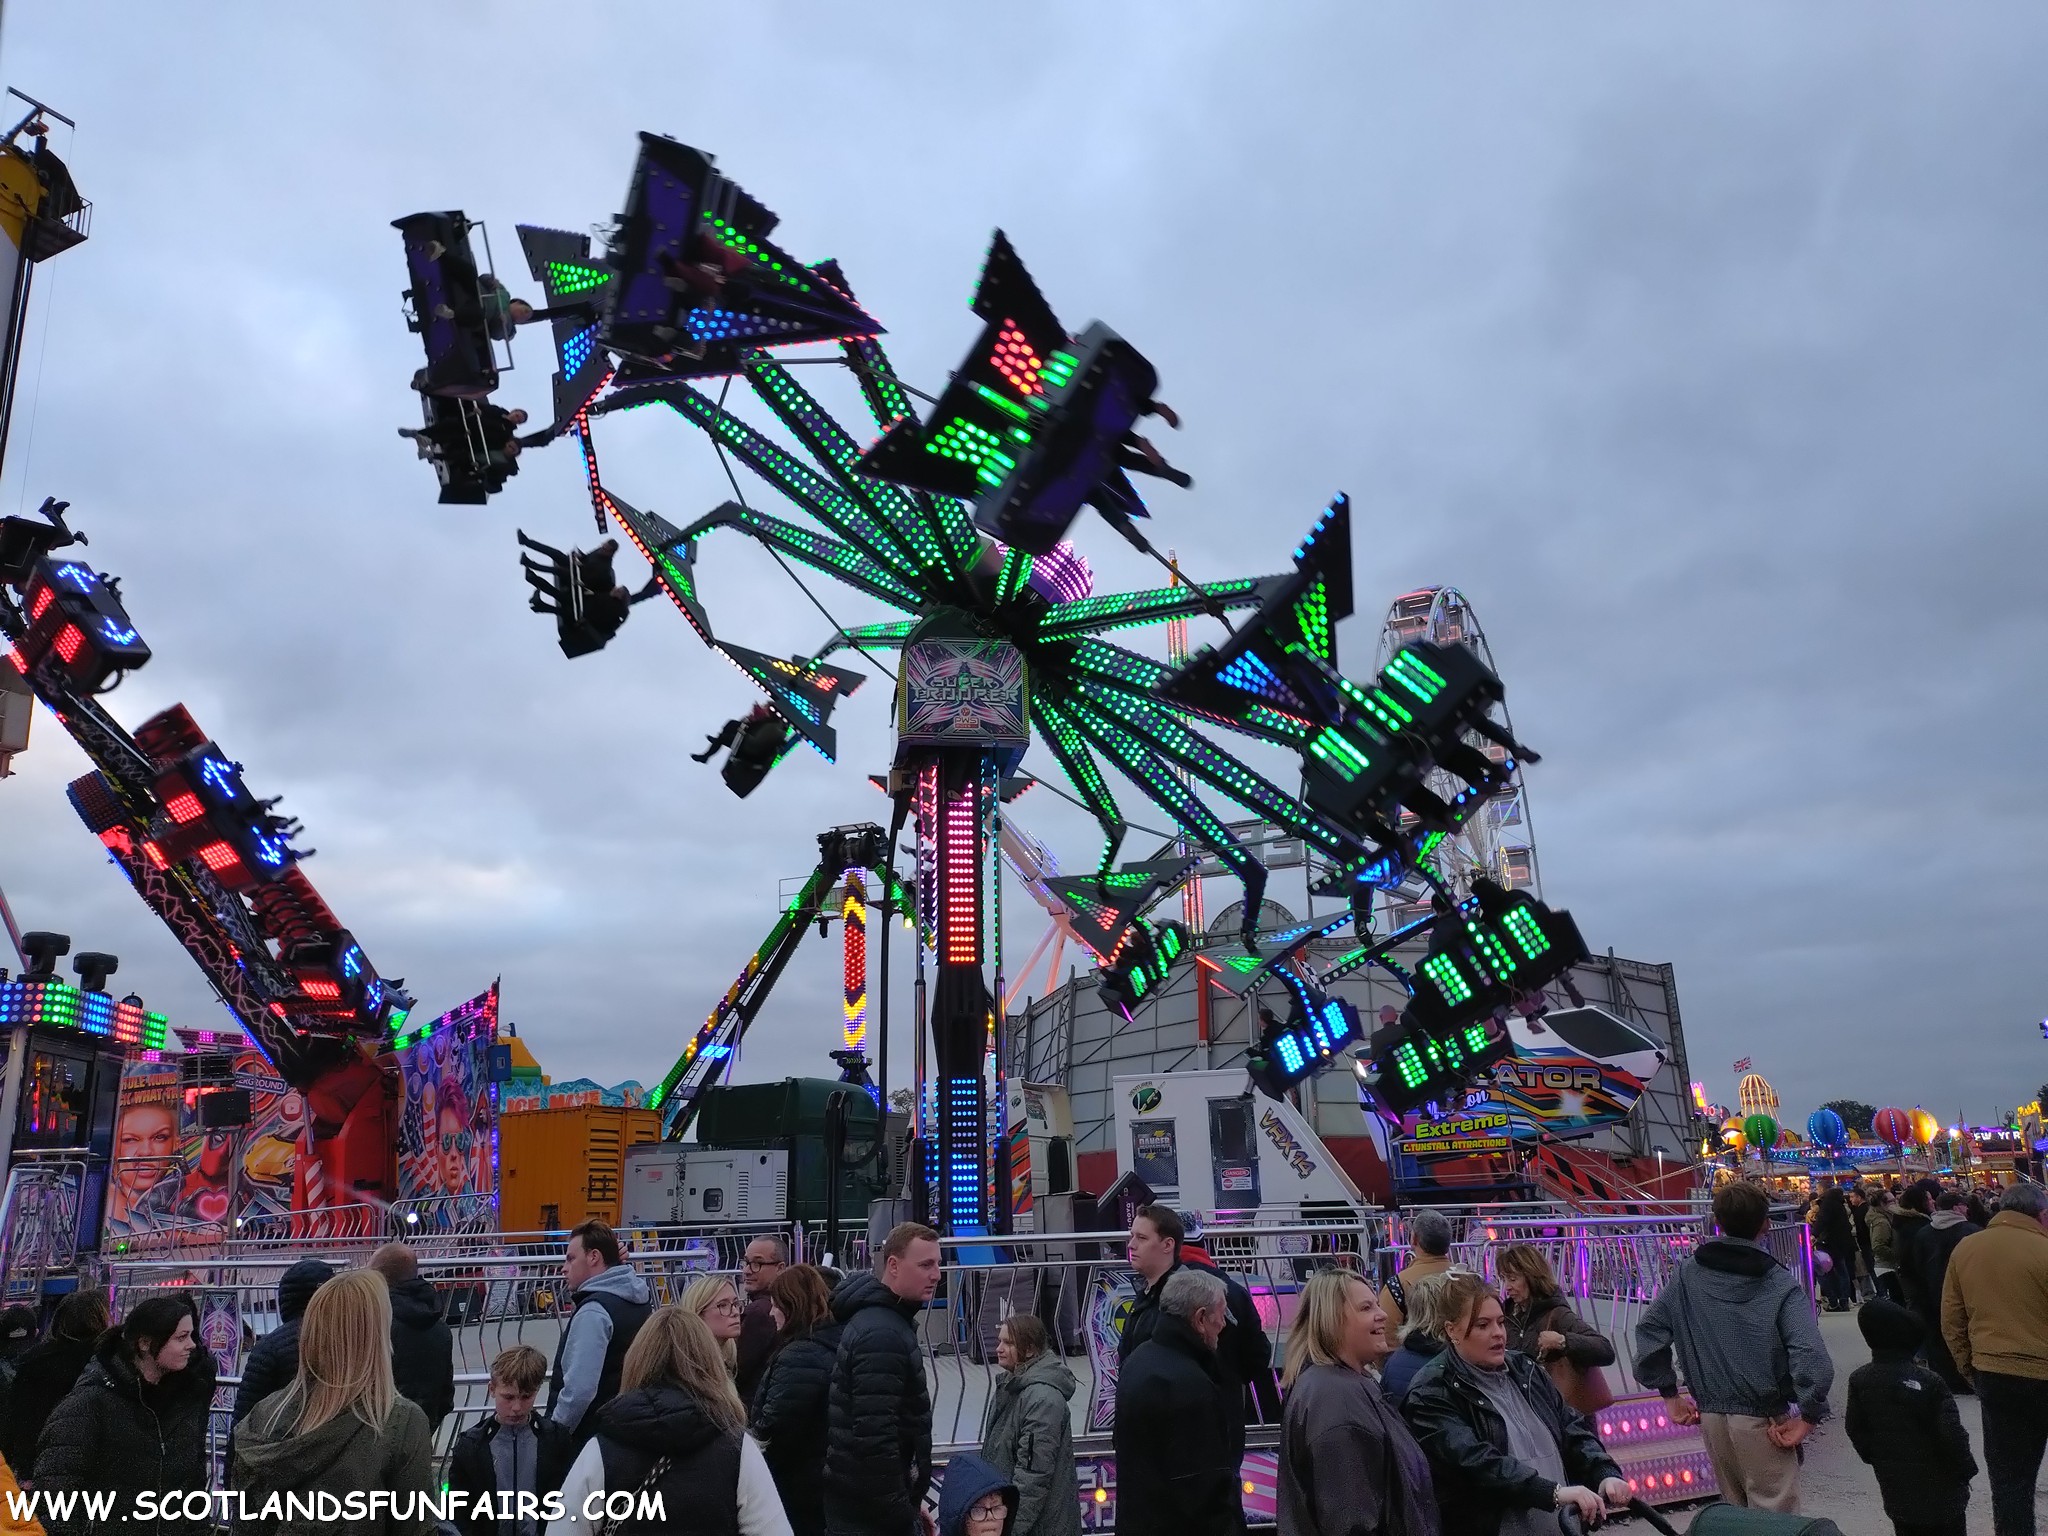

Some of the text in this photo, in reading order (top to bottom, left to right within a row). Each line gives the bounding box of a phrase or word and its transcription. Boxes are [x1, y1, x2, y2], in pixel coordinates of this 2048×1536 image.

[933, 677, 995, 688] SUPER
[912, 688, 1019, 703] TROOPER
[1476, 1065, 1601, 1089] ATOR
[1415, 1113, 1508, 1139] Extreme
[1138, 1136, 1171, 1146] DANGER
[1259, 1106, 1317, 1180] VRX 14
[1403, 1138, 1507, 1152] C.TUNSTALL ATTRACTIONS
